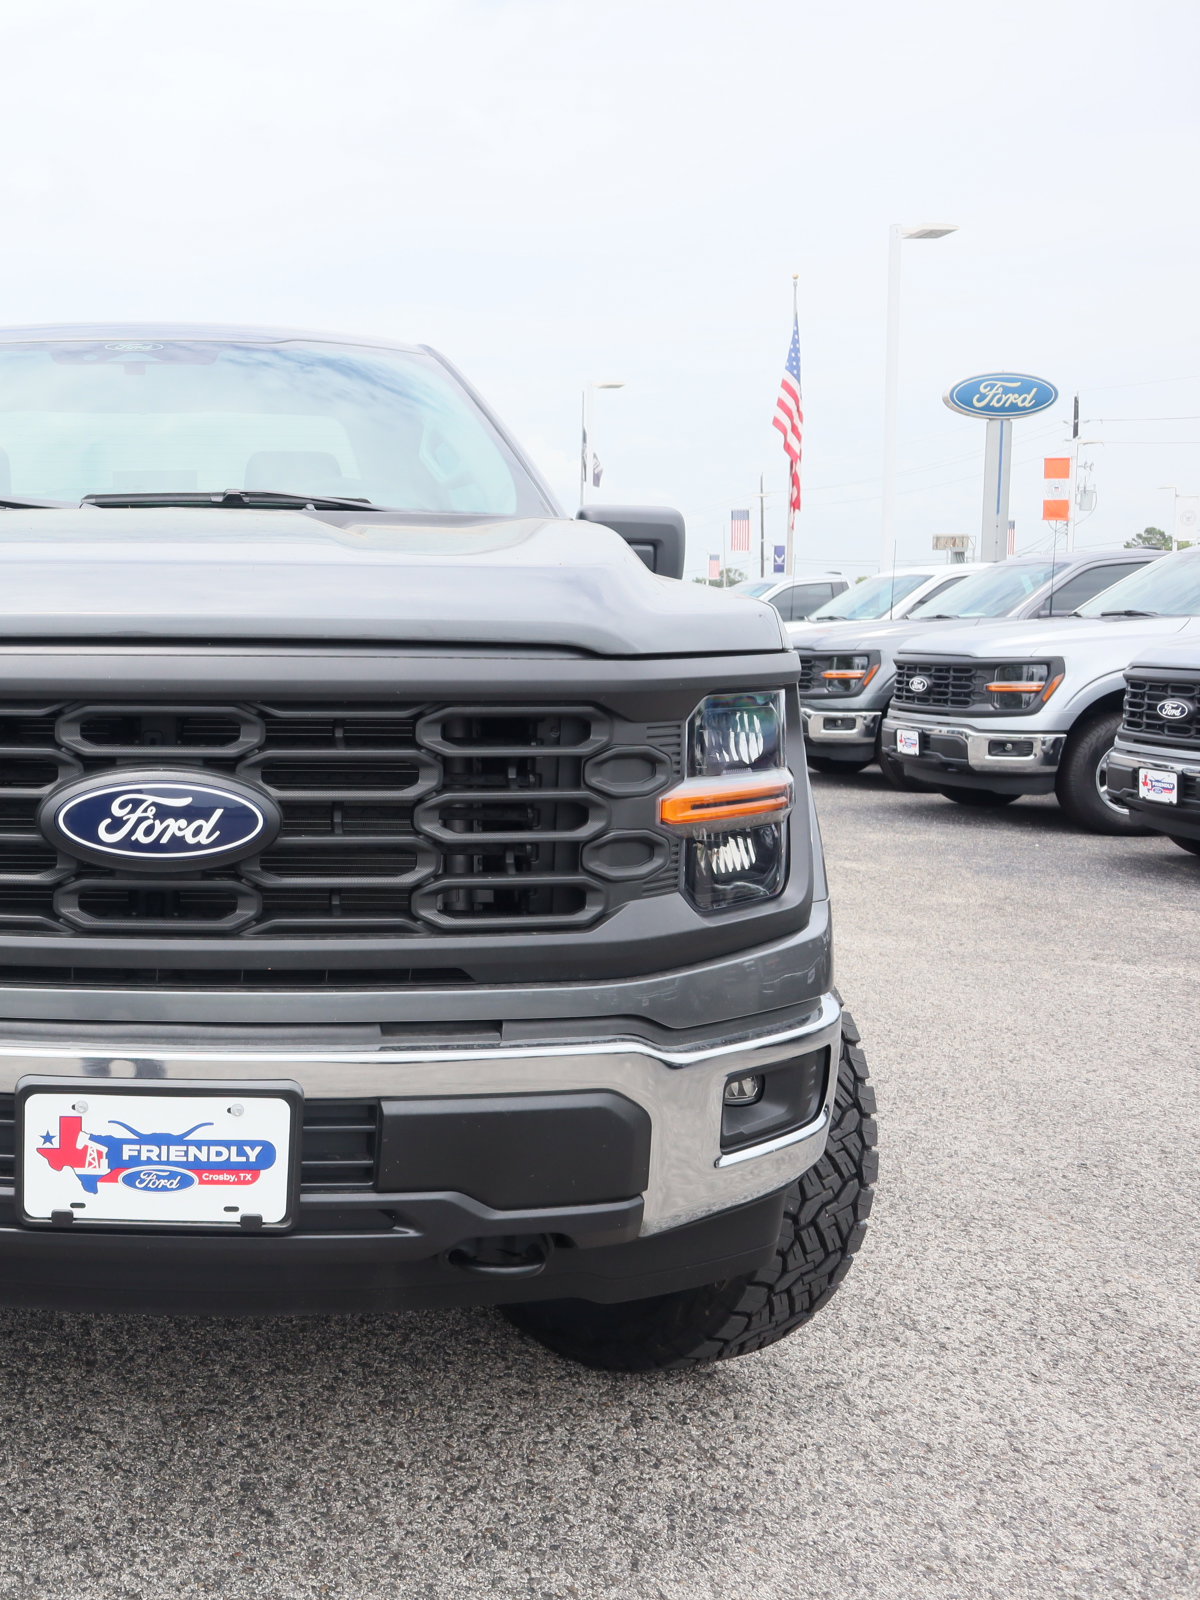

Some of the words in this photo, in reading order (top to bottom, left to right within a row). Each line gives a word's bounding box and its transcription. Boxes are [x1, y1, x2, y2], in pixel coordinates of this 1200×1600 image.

[972, 380, 1038, 408] Ford
[1162, 702, 1182, 716] Ford
[97, 793, 224, 844] Ford
[122, 1144, 263, 1162] FRIENDLY
[135, 1170, 181, 1189] Ford
[202, 1172, 238, 1182] Crosby,
[239, 1173, 252, 1181] TX
